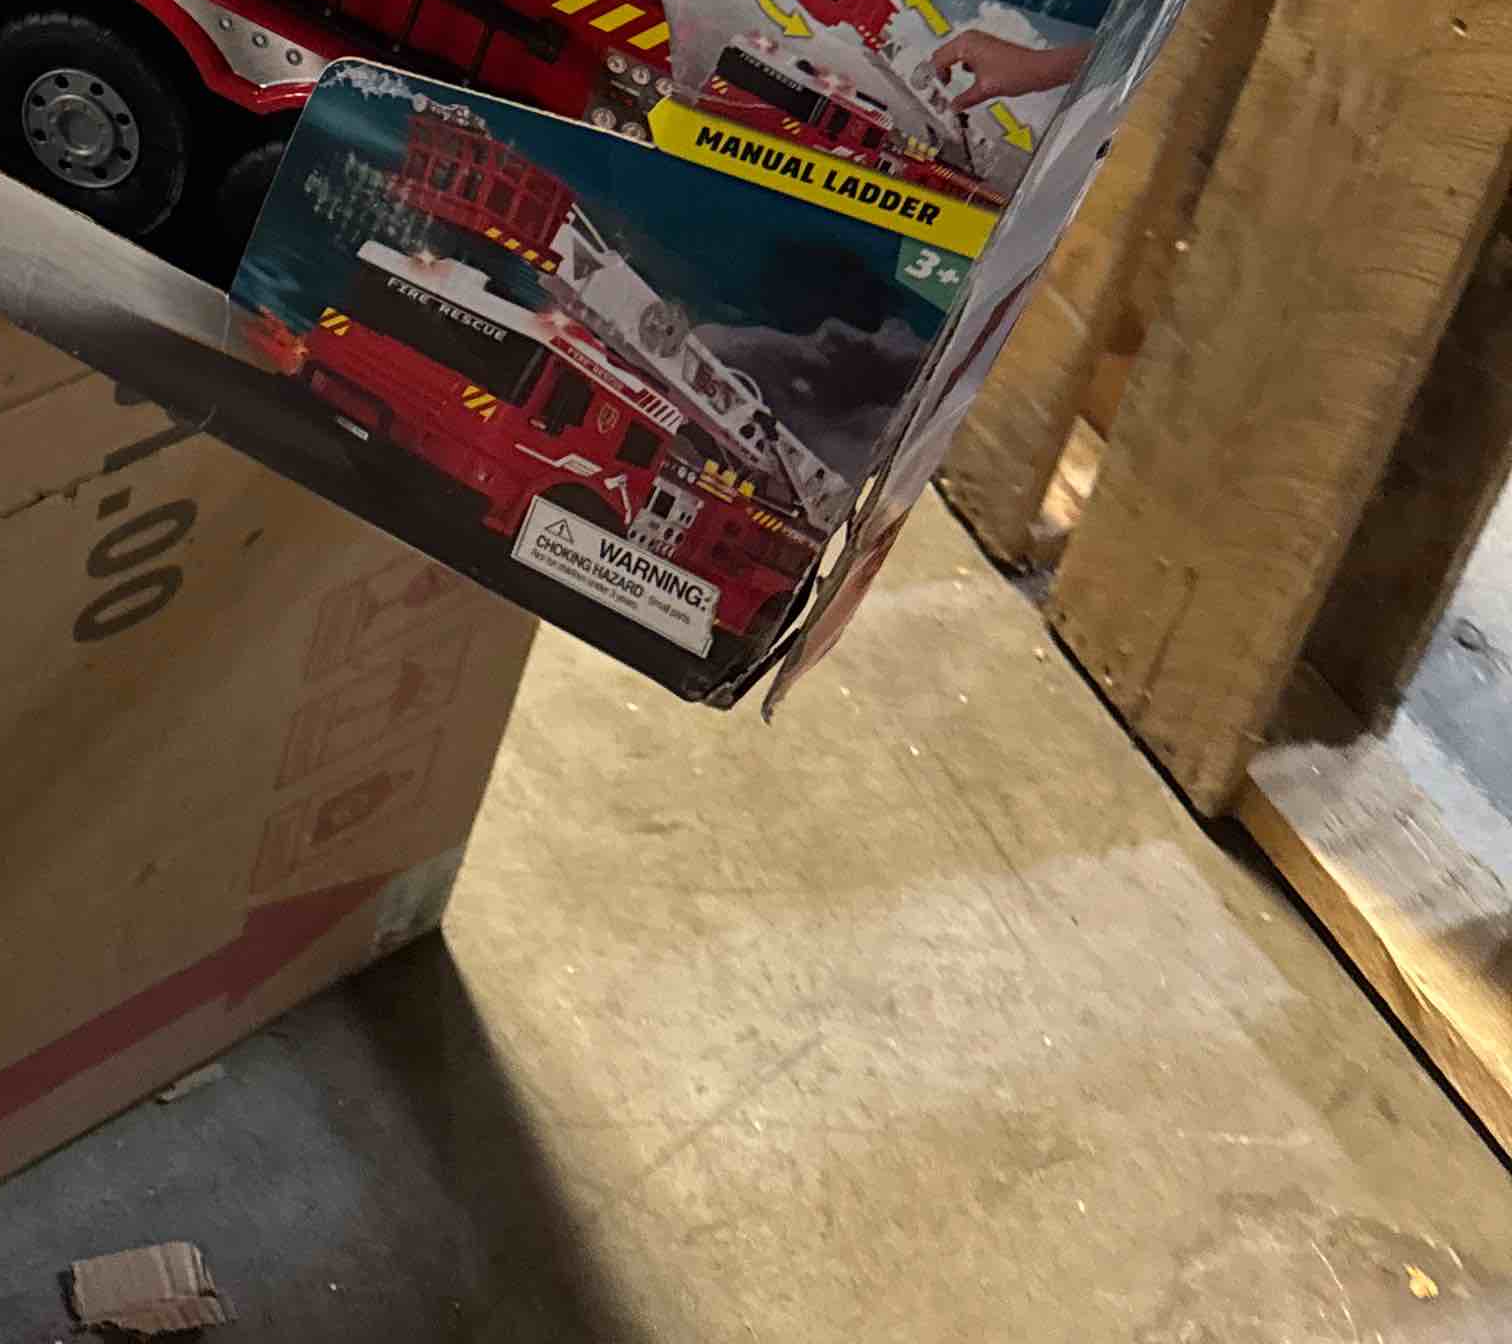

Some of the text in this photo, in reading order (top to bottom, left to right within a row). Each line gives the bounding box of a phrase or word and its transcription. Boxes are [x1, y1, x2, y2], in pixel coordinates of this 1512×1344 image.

[695, 126, 942, 226] MANUAL LADDER
[903, 249, 961, 285] 3+
[387, 275, 509, 344] FIRE RESCUE
[535, 534, 645, 599] CHOKING HAZARD
[598, 537, 712, 613] WARNING:
